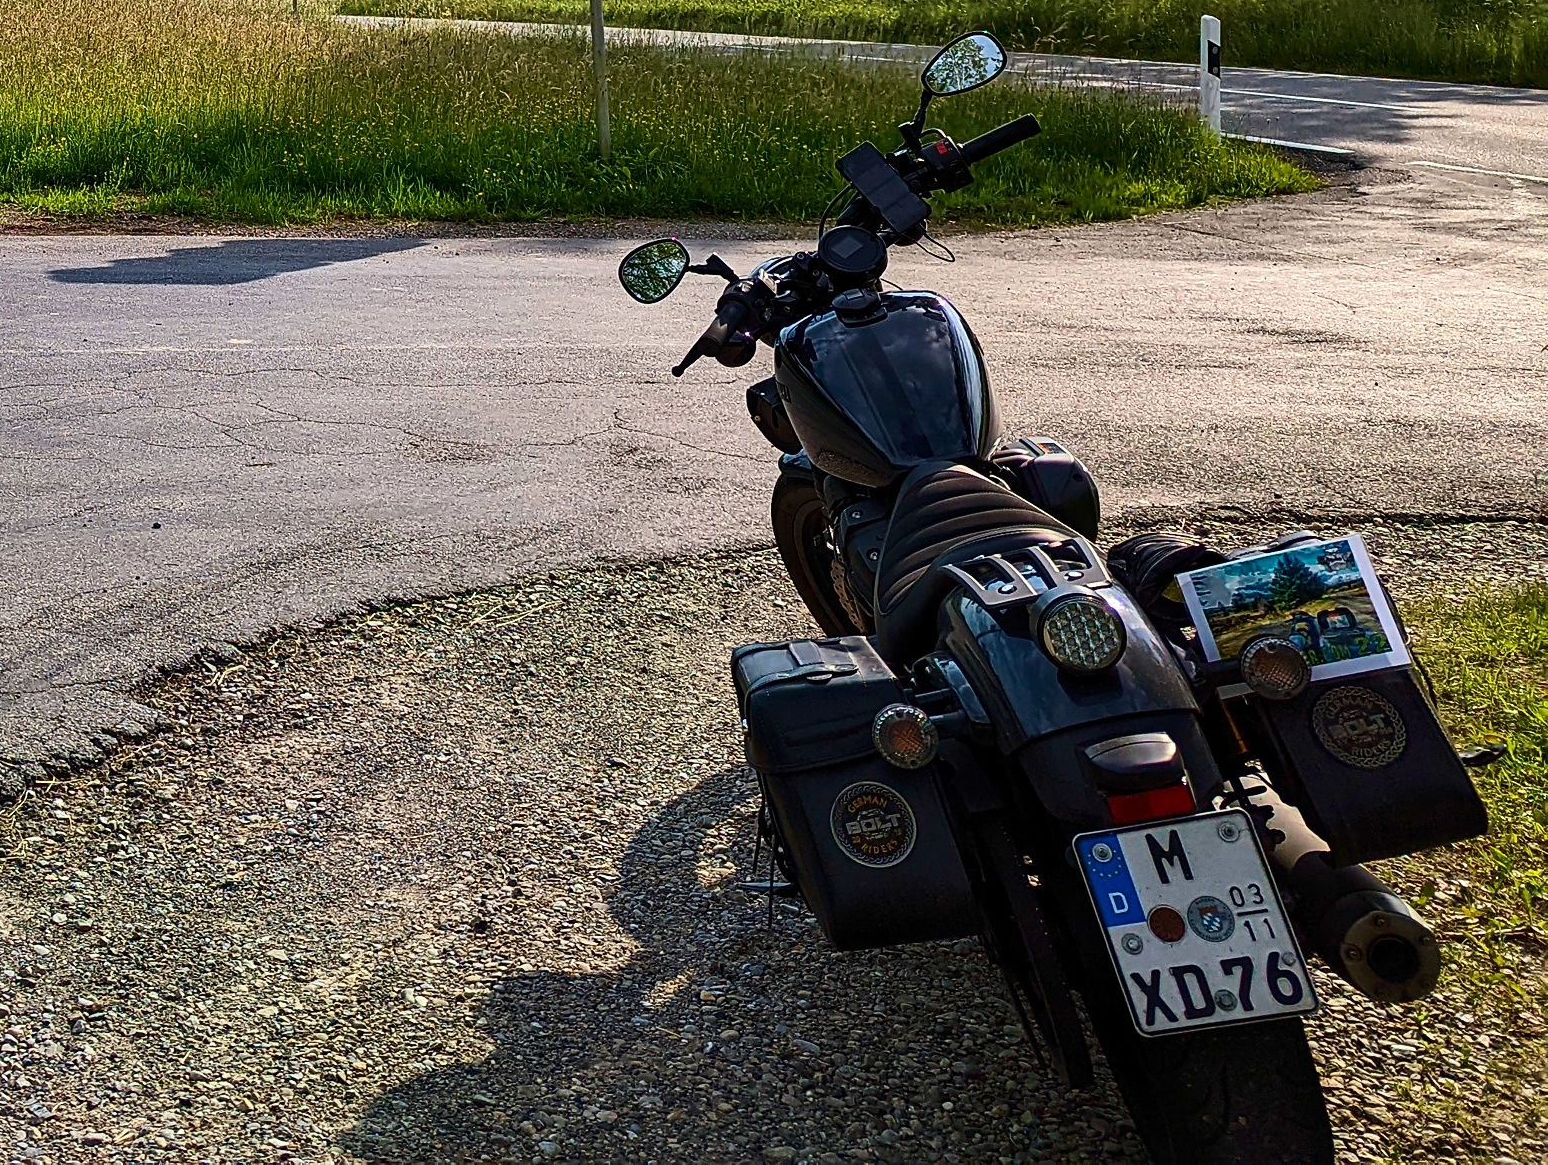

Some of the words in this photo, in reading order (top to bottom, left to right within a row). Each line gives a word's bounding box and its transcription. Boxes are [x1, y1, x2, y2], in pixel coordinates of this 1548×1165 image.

[1328, 714, 1385, 739] BOLT
[1352, 740, 1391, 757] RIDERS
[847, 794, 888, 813] GERMAN
[845, 813, 901, 835] BOLT
[861, 839, 898, 854] RIDERS
[1145, 829, 1195, 885] M
[1108, 891, 1130, 914] D
